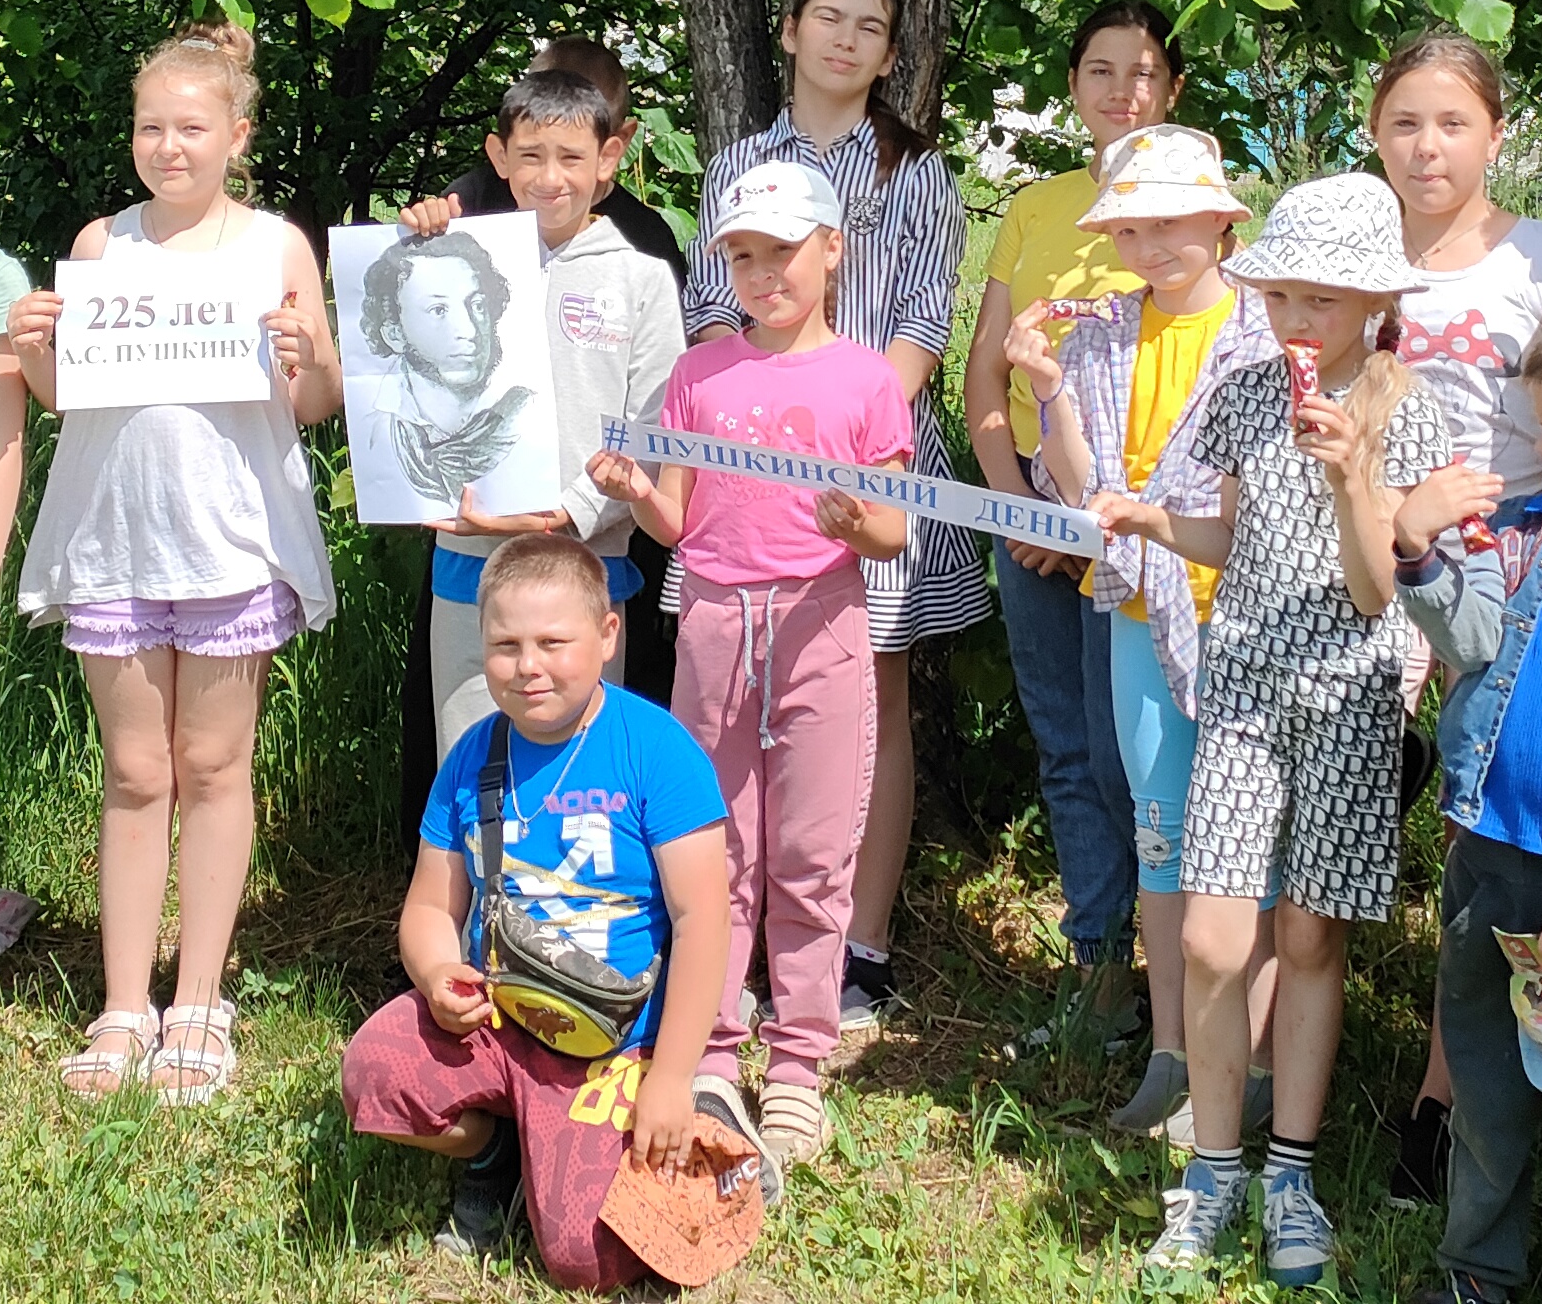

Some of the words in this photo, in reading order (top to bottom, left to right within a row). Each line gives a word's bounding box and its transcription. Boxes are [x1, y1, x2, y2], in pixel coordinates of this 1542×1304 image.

[86, 295, 156, 330] 225
[169, 301, 240, 327] лет
[116, 339, 256, 363] ПУШКИНУ
[597, 341, 618, 353] CLUB
[645, 431, 939, 509] ПУШКИНСКИЙ
[974, 497, 1081, 543] ДЕНЬ
[718, 1157, 760, 1196] UFC
